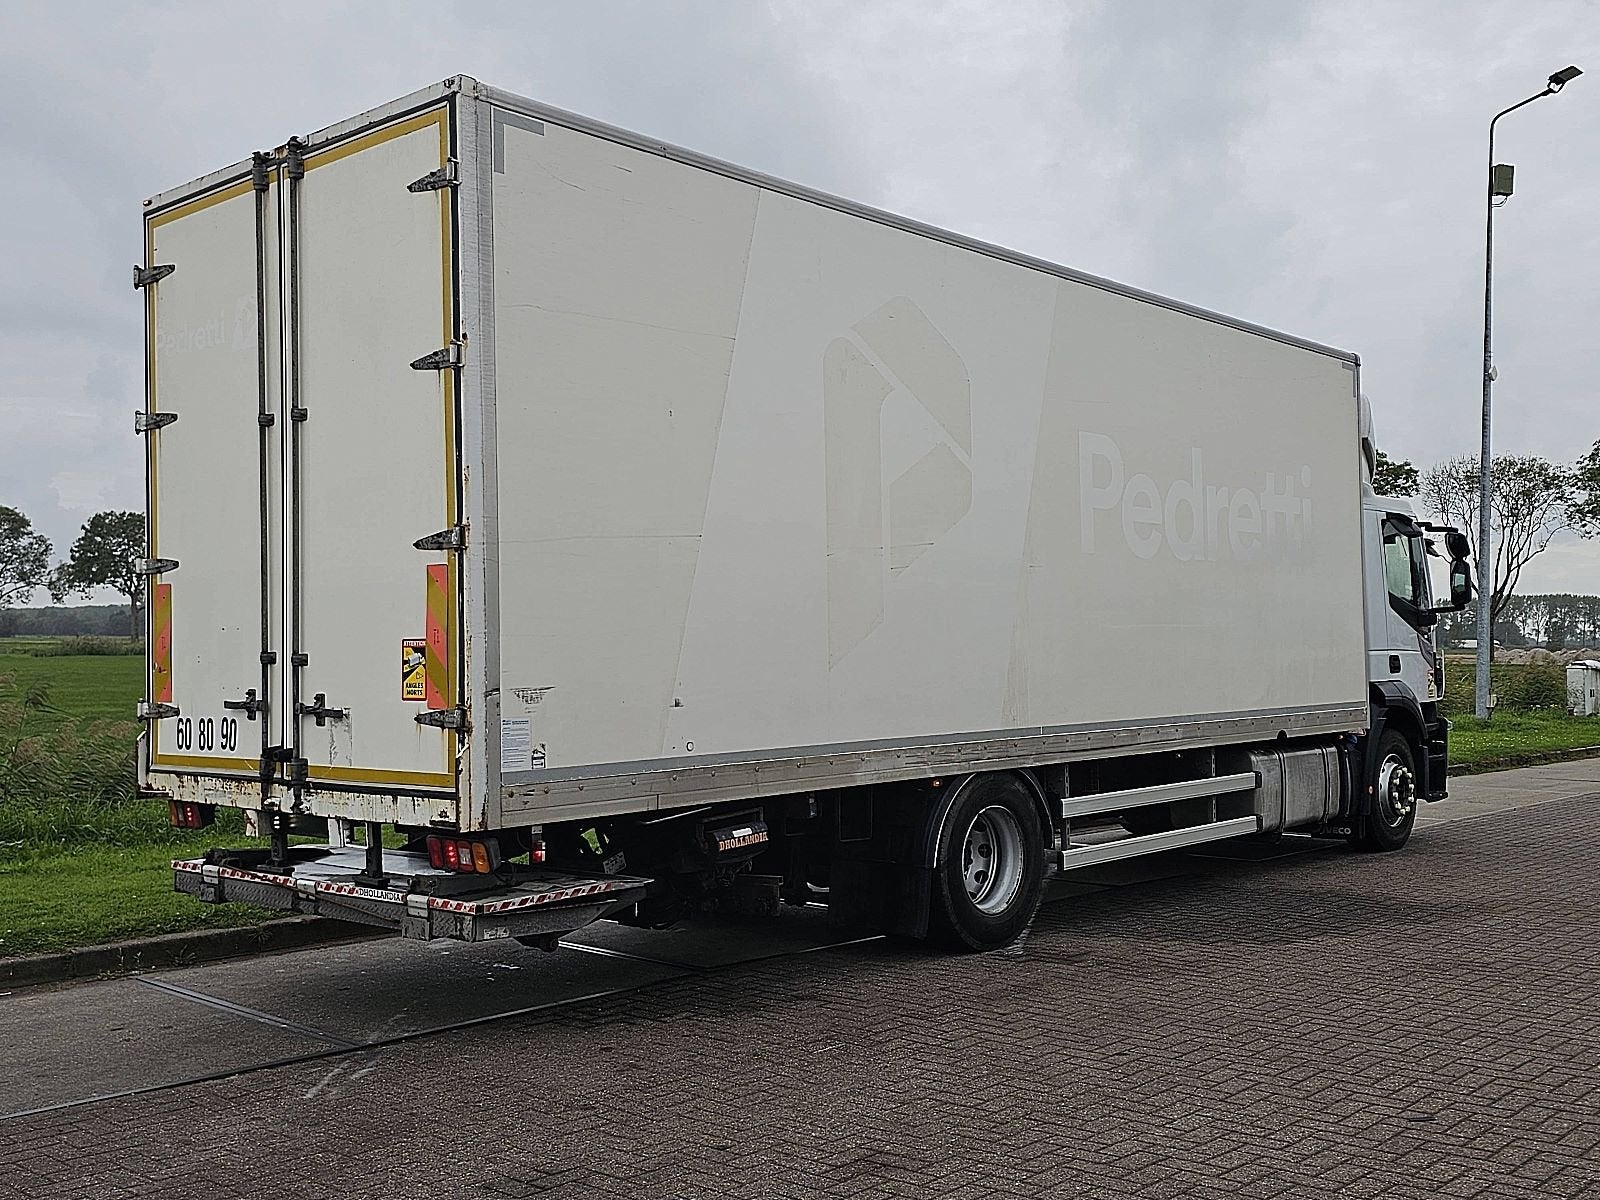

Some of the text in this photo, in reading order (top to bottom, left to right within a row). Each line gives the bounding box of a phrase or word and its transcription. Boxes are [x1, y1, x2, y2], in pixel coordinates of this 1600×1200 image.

[1078, 430, 1313, 562] Pedretti
[176, 716, 237, 751] 60 80 90
[719, 831, 769, 851] DHOLLANDIA
[359, 888, 401, 902] DHOLLANDIA
